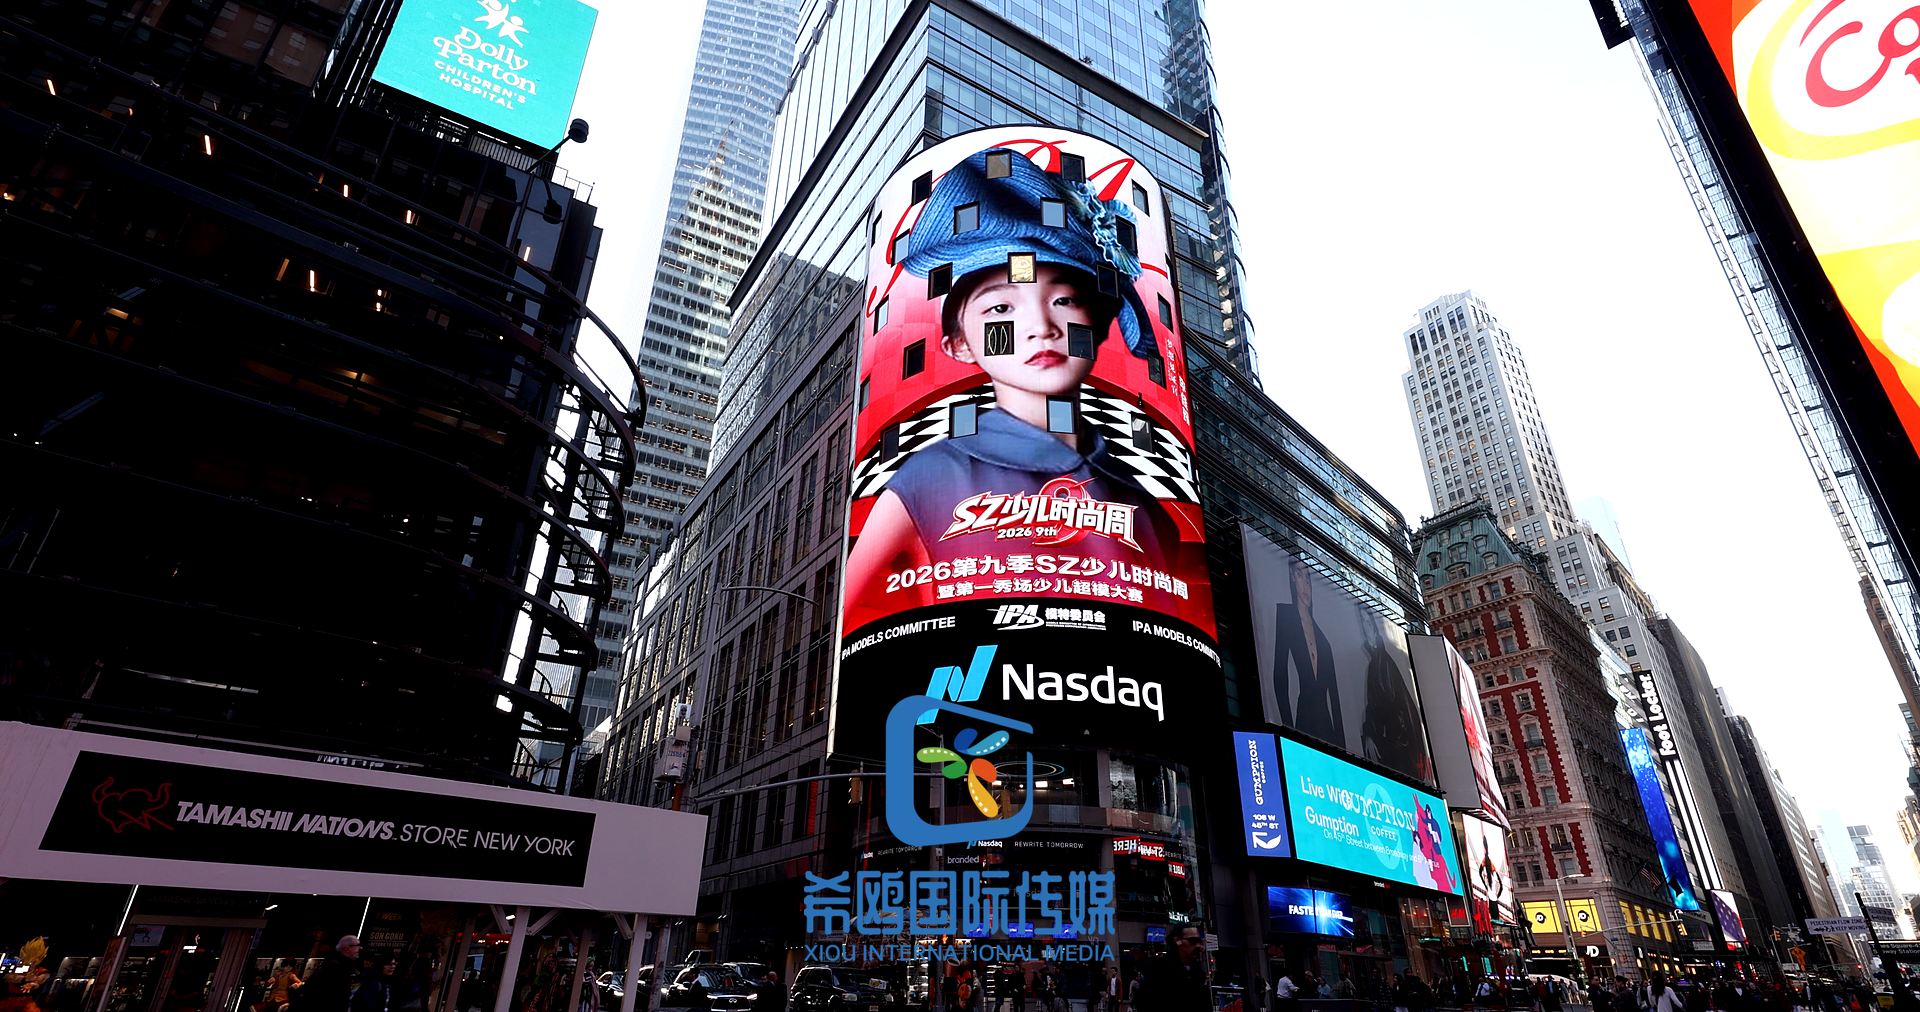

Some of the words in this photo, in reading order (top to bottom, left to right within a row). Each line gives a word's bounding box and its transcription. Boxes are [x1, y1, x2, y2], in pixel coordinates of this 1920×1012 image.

[454, 25, 529, 71] Dolly
[433, 36, 537, 95] Parton
[434, 60, 527, 104] CHILDREN'S
[440, 73, 514, 110] HOSPITAL
[997, 527, 1032, 539] 2026
[1035, 526, 1057, 537] 9th
[886, 554, 1189, 600] 2026第九季SZ少儿时尚周
[936, 577, 1144, 604] 暨第一秀场少儿超模大赛
[991, 604, 1040, 625] IPA
[851, 631, 884, 654] MODELS
[884, 616, 956, 640] COMMITTEE
[1132, 620, 1152, 635] IPA
[1153, 625, 1192, 647] MODELS
[1002, 663, 1165, 722] Nasdaq
[1639, 673, 1665, 722] Locker
[1652, 723, 1677, 756] Foot
[1248, 740, 1264, 805] GUMPTION
[1300, 775, 1325, 799] Live
[176, 800, 293, 832] TAMASHII
[400, 823, 469, 848] STORE
[473, 830, 520, 851] NEW
[524, 835, 575, 857] YORK
[1305, 805, 1360, 838] Gumption
[1370, 825, 1398, 841] COFFEE
[947, 855, 980, 864] branded
[977, 840, 1003, 848] Nasdaq
[1047, 841, 1084, 849] TOMORROW
[1586, 945, 1600, 957] JD
